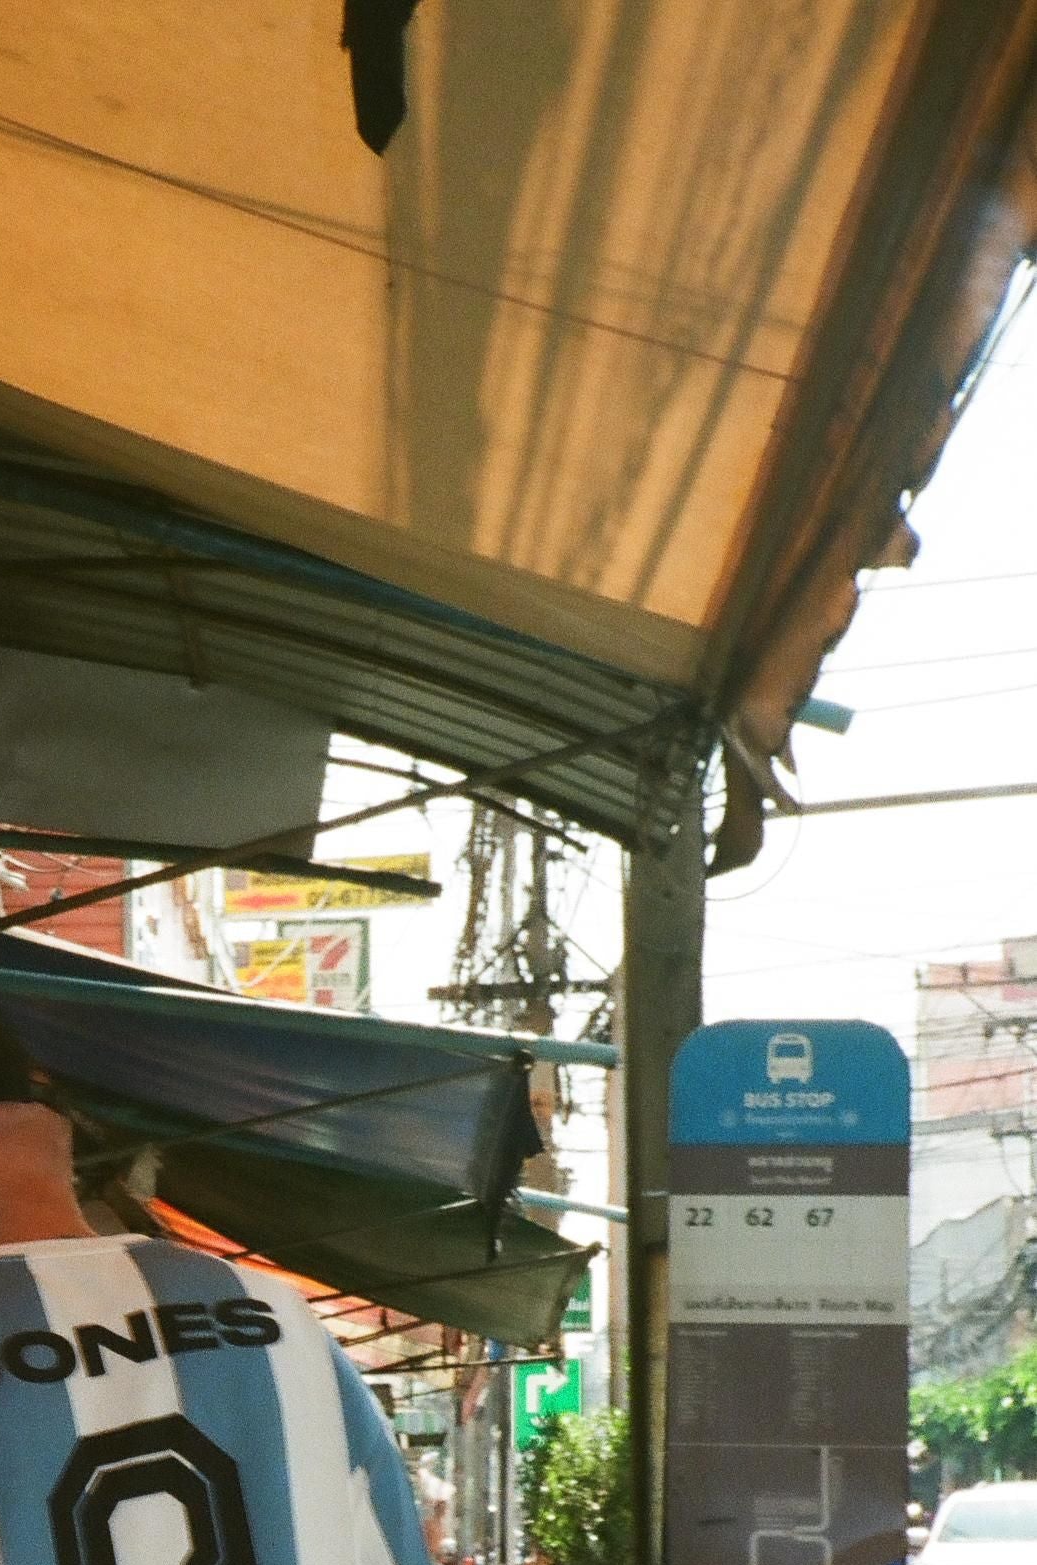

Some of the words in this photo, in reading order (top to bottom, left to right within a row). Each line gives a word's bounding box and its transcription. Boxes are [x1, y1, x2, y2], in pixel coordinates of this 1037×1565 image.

[743, 1092, 782, 1108] BUS
[784, 1092, 835, 1108] STOP
[685, 1207, 713, 1227] 22
[745, 1207, 774, 1227] 62
[805, 1207, 834, 1227] 67
